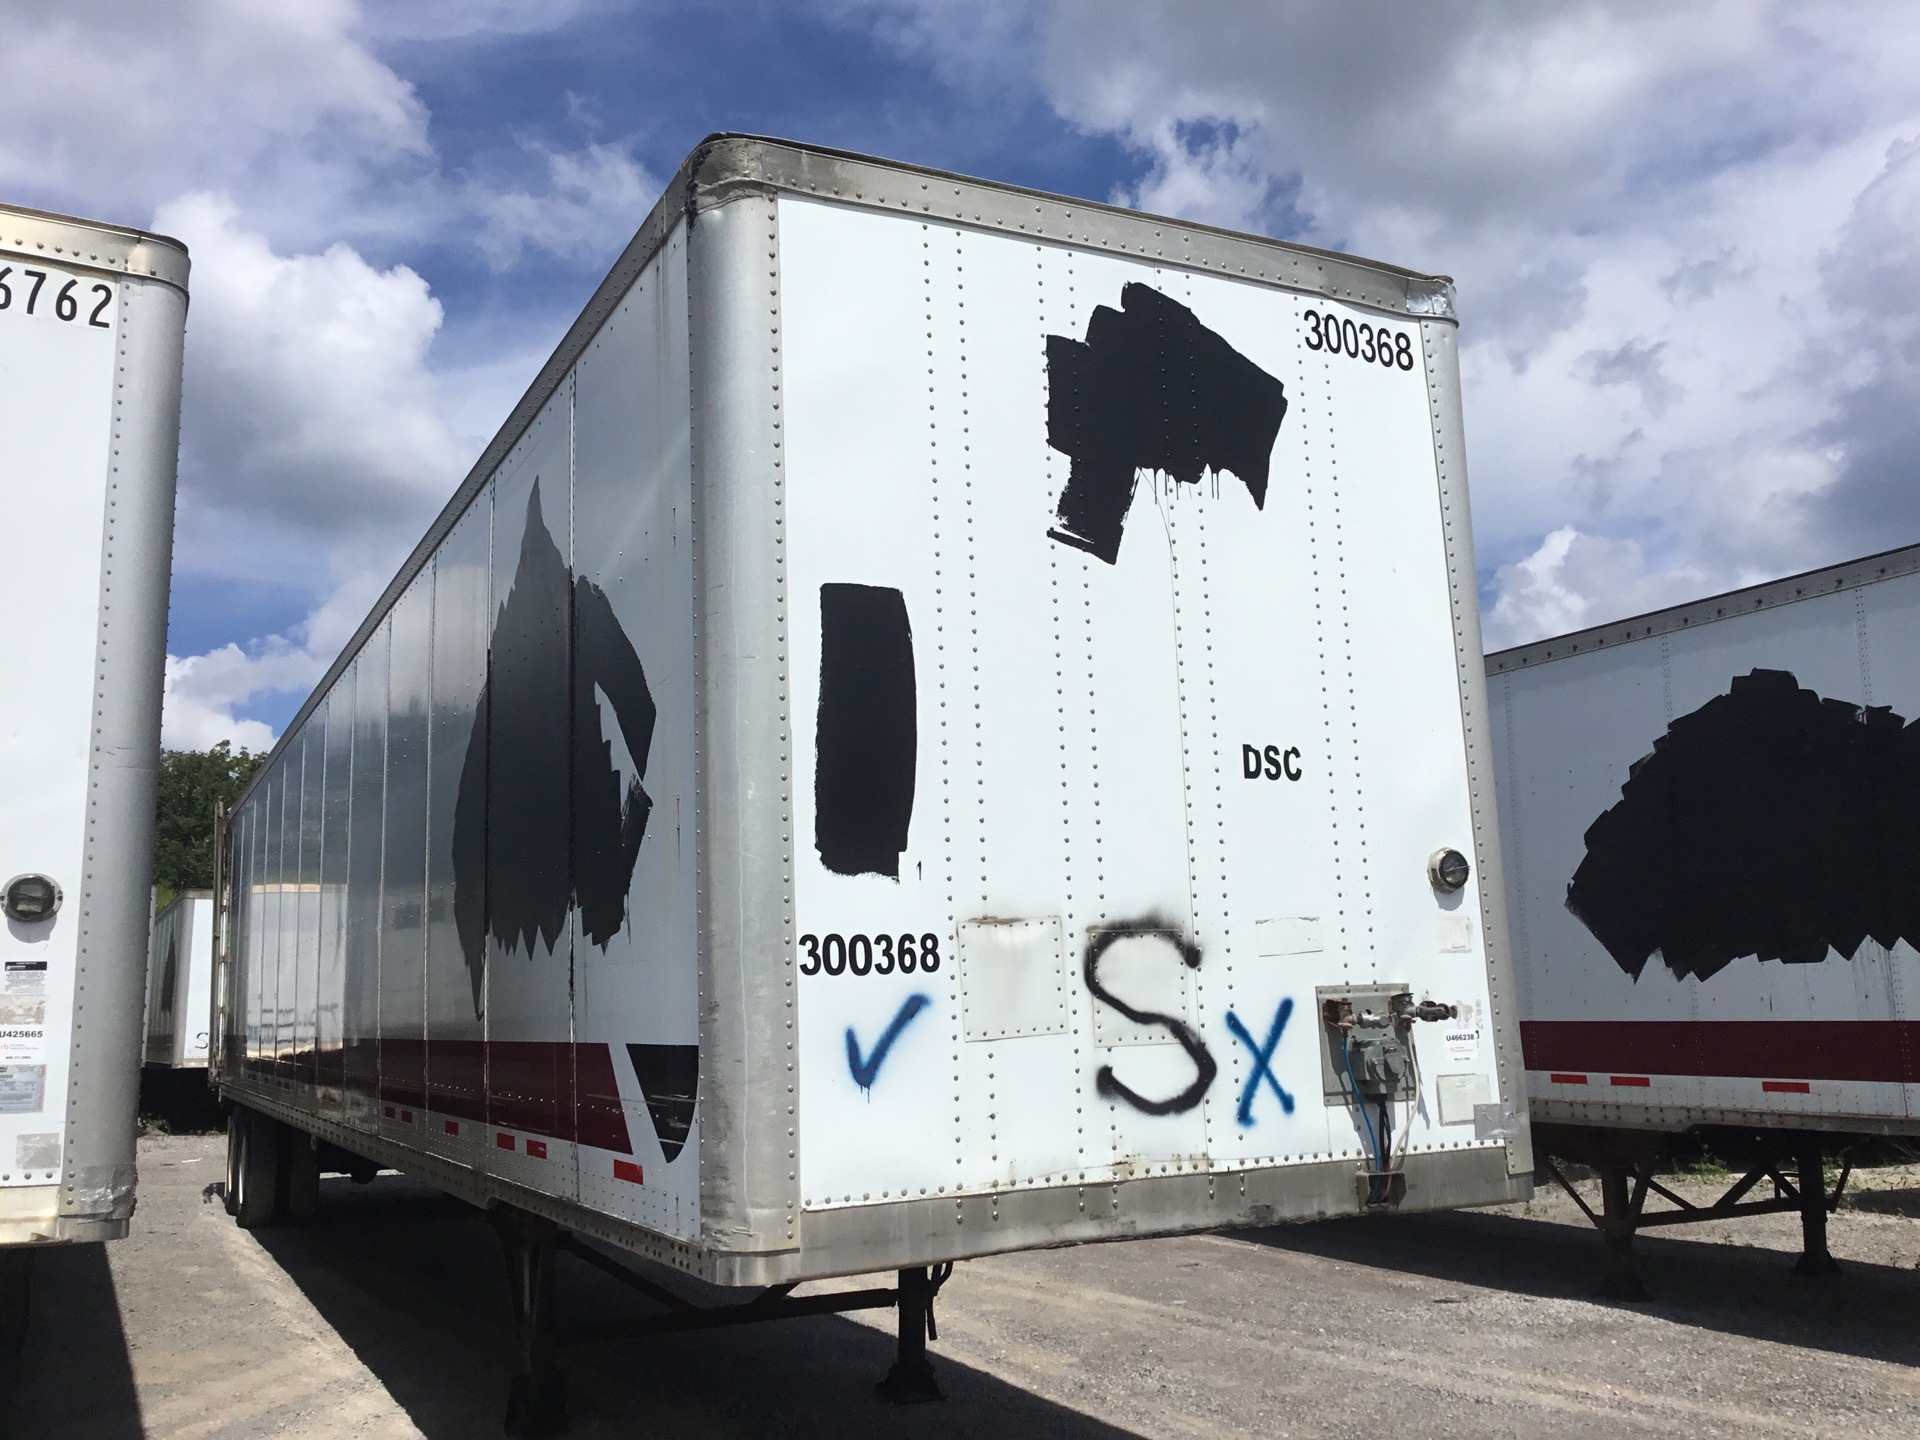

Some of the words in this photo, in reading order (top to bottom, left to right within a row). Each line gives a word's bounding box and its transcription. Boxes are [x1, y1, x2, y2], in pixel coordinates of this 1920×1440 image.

[1303, 310, 1414, 371] 300368
[1242, 744, 1302, 781] DSC
[799, 933, 940, 976] 300368
[1084, 917, 1217, 1116] S
